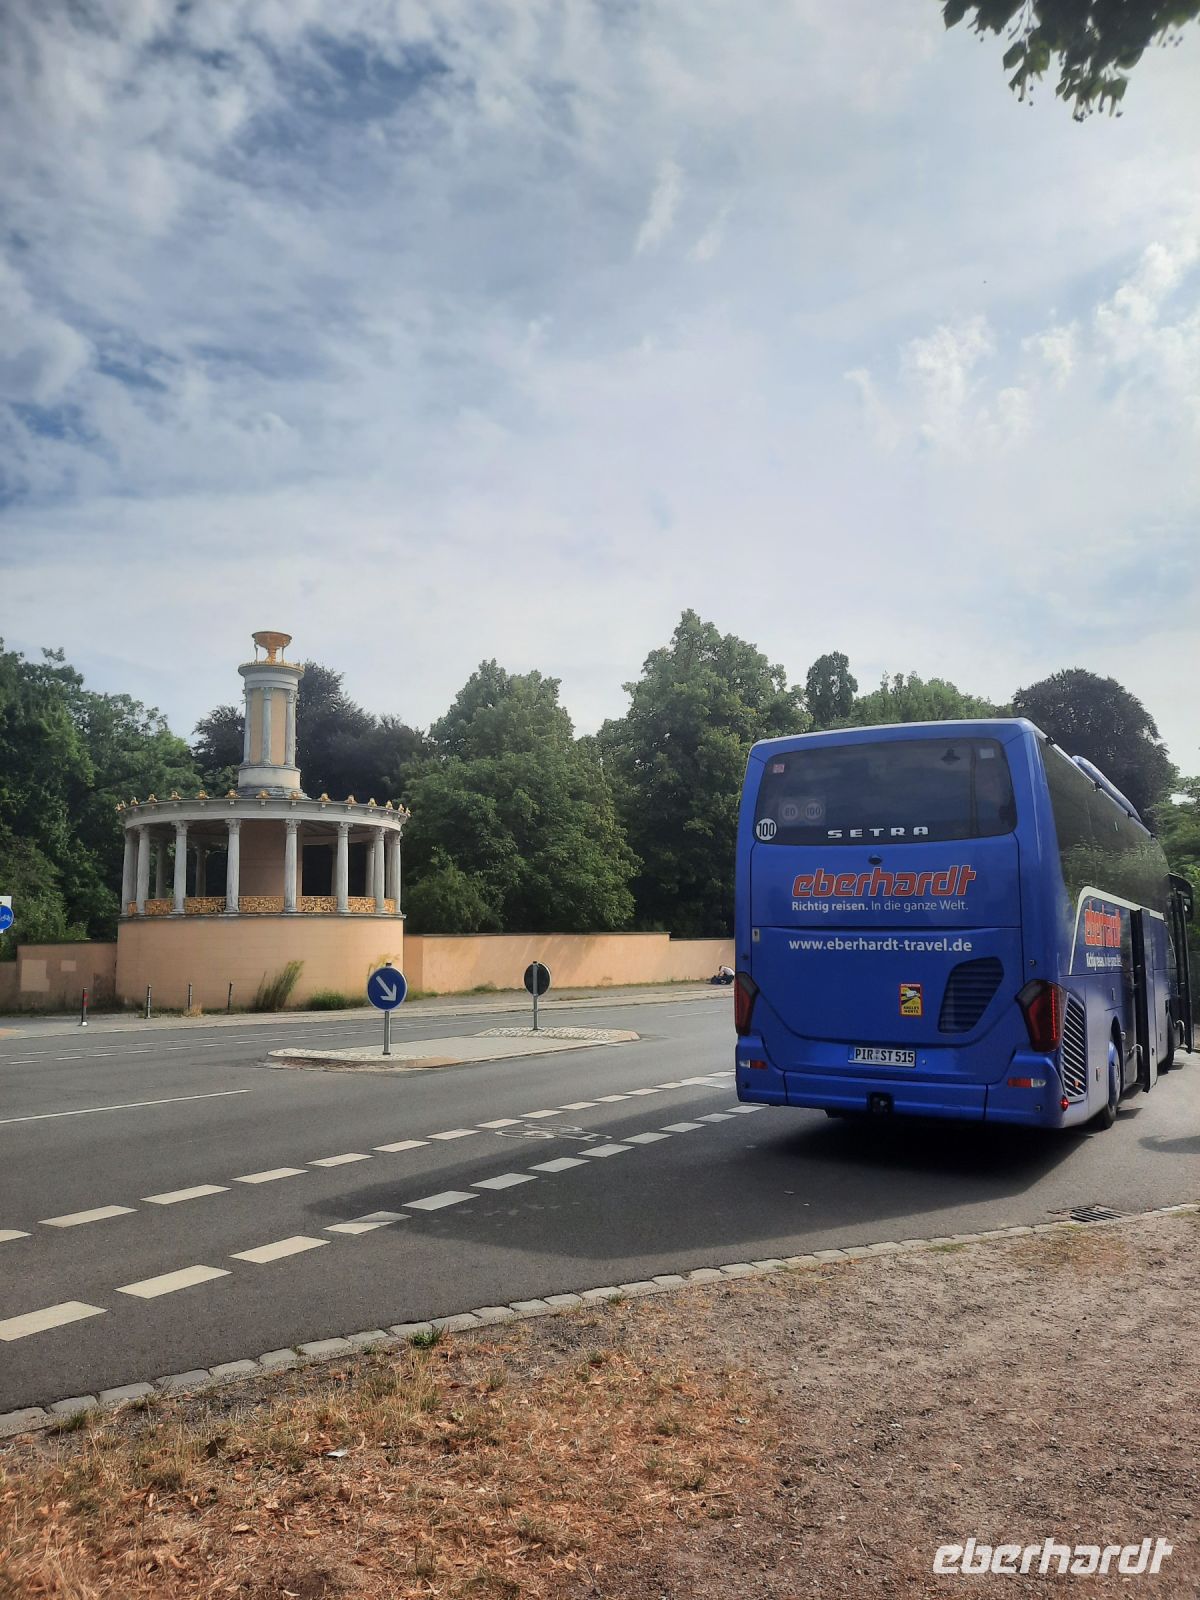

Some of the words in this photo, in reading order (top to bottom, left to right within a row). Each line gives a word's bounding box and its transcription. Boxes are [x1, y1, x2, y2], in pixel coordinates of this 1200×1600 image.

[757, 822, 776, 837] 100
[827, 826, 929, 839] SETRA
[792, 865, 977, 898] eberhardt
[792, 901, 829, 913] Richtig
[831, 901, 869, 911] reisen.
[871, 901, 881, 911] In
[884, 900, 901, 911] die
[903, 902, 937, 913] ganze
[939, 899, 969, 911] Welt.
[788, 937, 973, 952] www.eberhardt-travel.de
[855, 1048, 874, 1060] PIR
[880, 1050, 893, 1062] ST
[895, 1051, 915, 1063] 515
